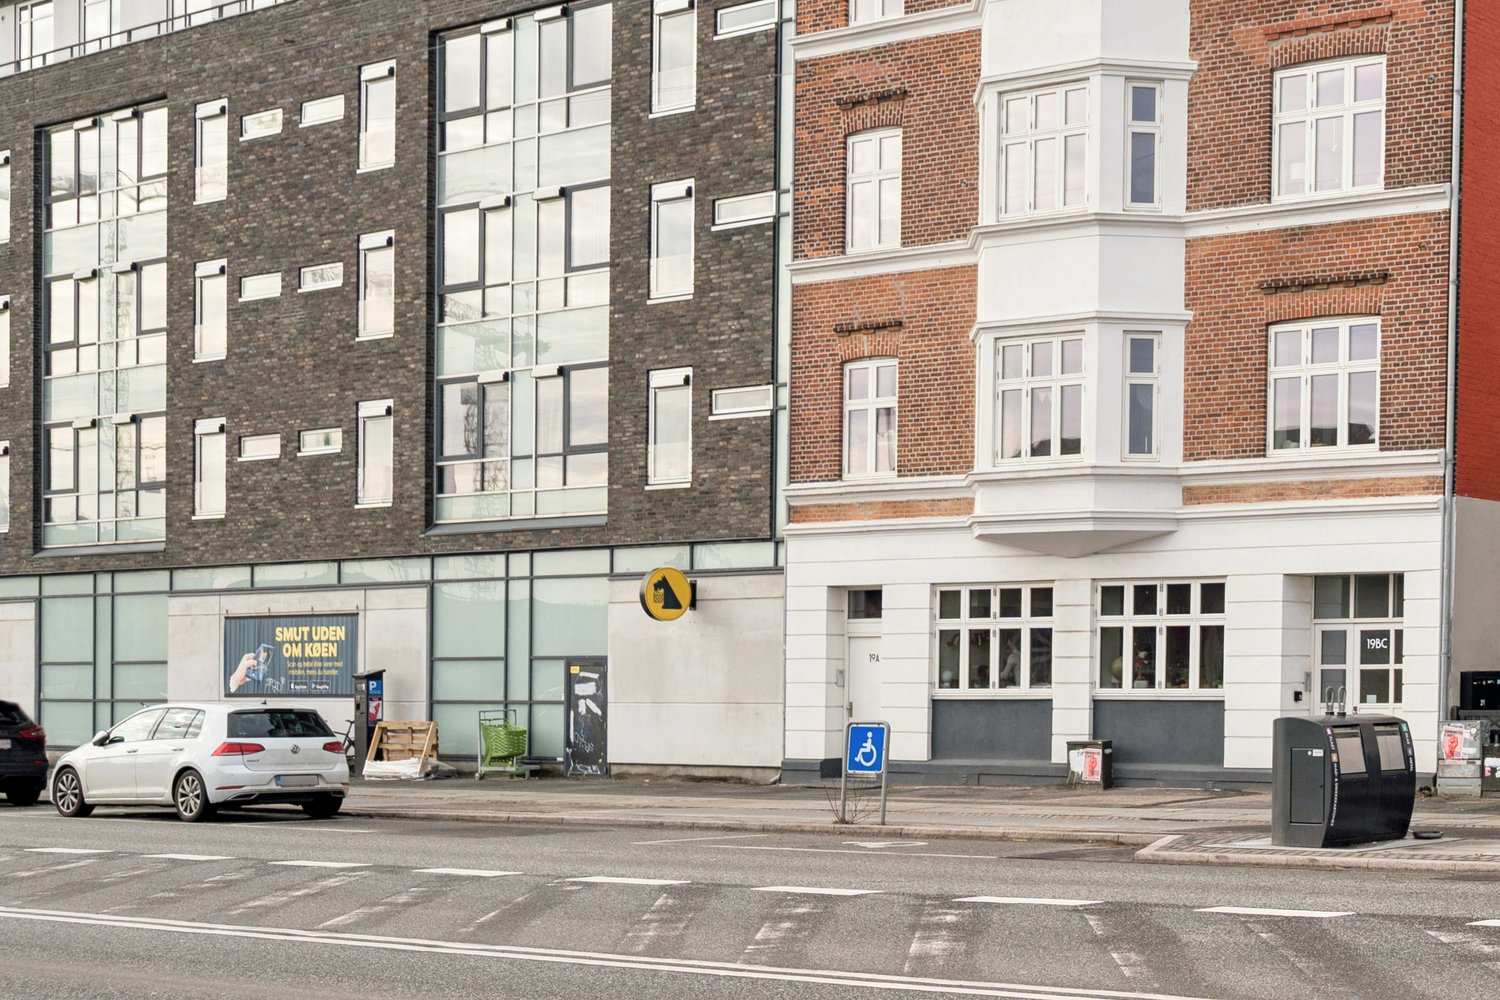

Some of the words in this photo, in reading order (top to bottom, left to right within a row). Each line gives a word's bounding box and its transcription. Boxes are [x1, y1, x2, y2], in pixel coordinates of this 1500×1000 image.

[275, 626, 310, 642] SMUT
[312, 626, 346, 640] UDEN
[1366, 638, 1388, 649] 19BC
[282, 643, 302, 657] OM
[304, 642, 338, 657] KØEN
[869, 653, 880, 662] 19A
[369, 681, 377, 690] P
